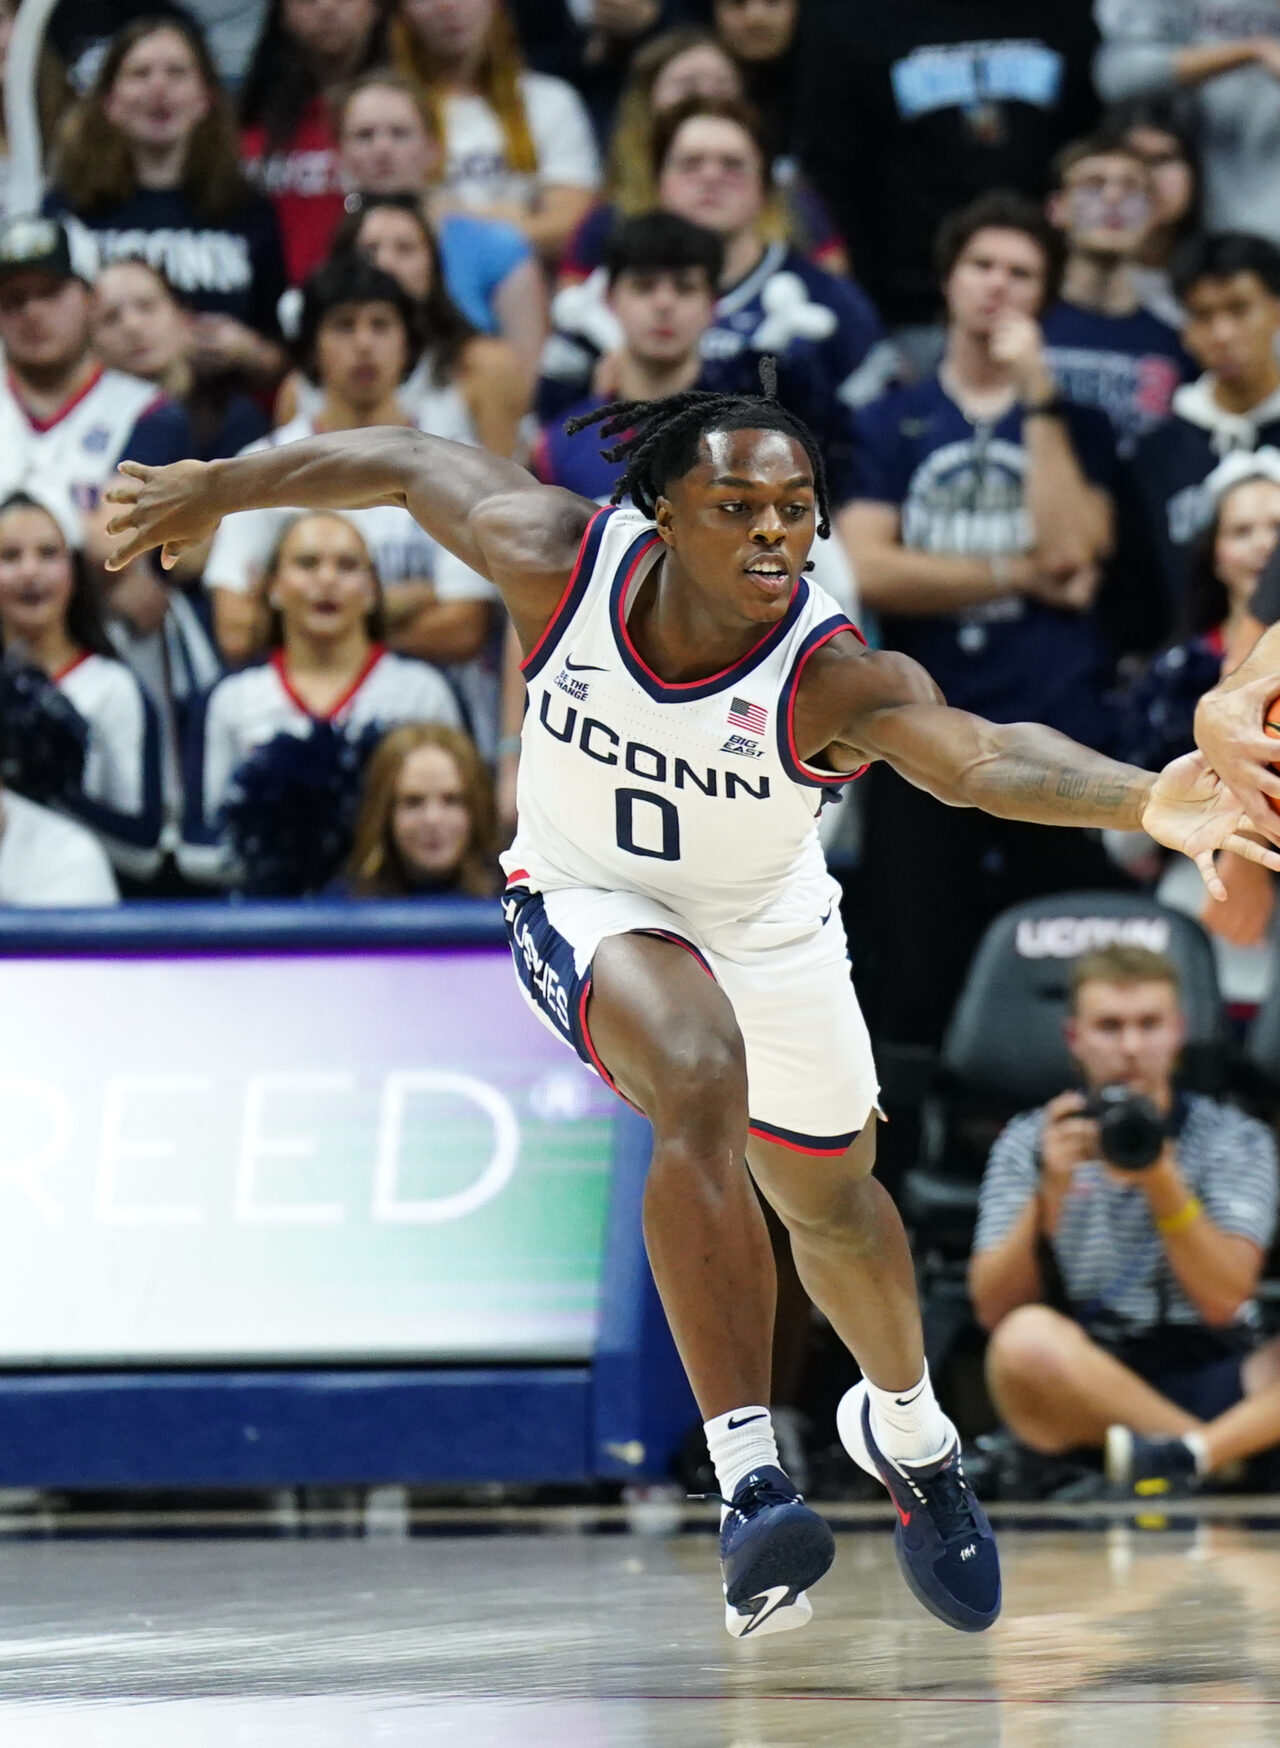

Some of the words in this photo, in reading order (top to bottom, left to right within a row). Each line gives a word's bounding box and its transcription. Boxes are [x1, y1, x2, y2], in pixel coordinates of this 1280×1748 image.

[553, 675, 589, 702] CHANGE
[570, 678, 590, 693] THE
[539, 689, 771, 800] UCONN
[722, 741, 767, 758] EAST
[728, 734, 759, 749] BIG
[615, 787, 681, 862] 0
